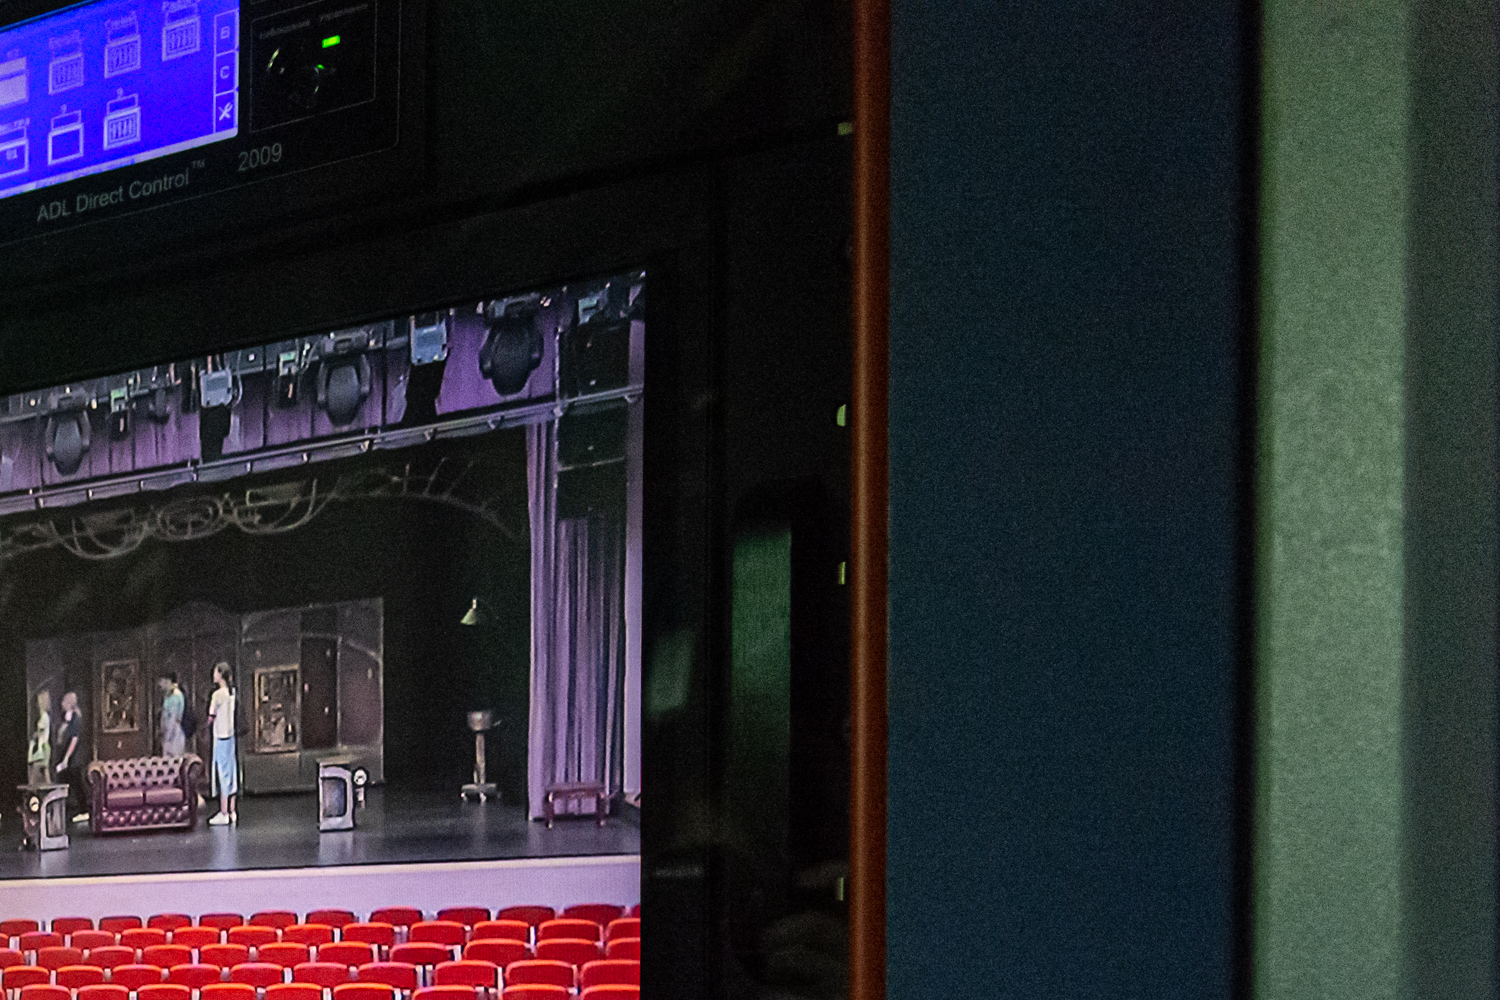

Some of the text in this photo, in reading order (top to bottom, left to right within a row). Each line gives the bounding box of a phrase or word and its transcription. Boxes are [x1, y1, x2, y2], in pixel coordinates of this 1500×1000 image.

[37, 201, 71, 223] ADL
[76, 185, 124, 213] Direct
[237, 142, 283, 173] 2009
